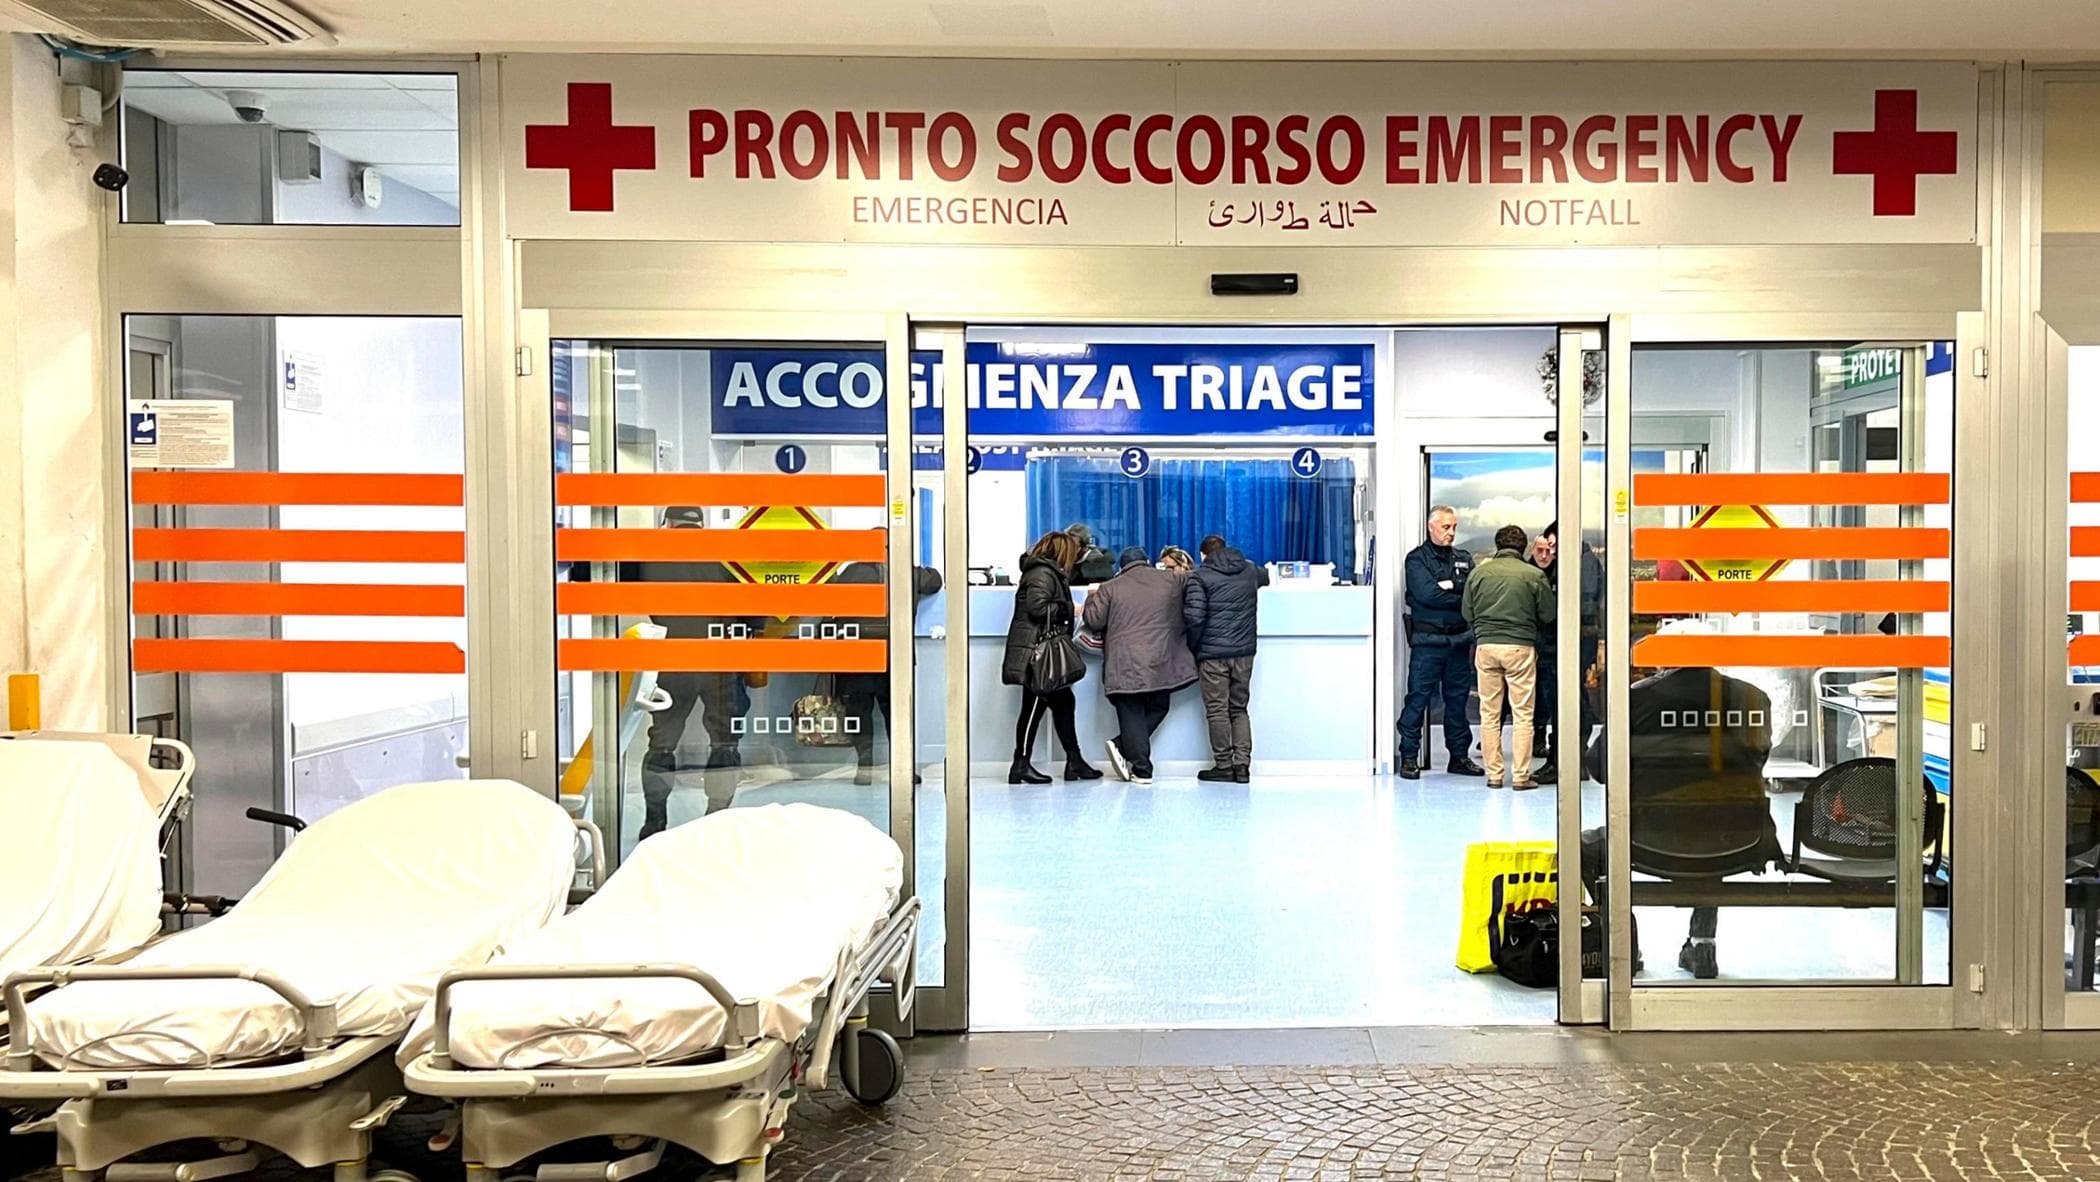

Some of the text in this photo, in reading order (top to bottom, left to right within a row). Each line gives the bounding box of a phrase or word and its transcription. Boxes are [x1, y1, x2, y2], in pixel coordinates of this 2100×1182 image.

[689, 108, 1803, 186] PRONTO SOCCORSO EMERGENCY
[853, 195, 1069, 225] EMERGENCIA
[1208, 200, 1377, 230] حالة طوارئ
[1500, 199, 1641, 226] NOTFALL
[1152, 364, 1362, 411] TRIAGE
[784, 447, 795, 470] 1
[1127, 449, 1143, 473] 3
[1298, 450, 1315, 473] 4
[764, 574, 800, 584] PORTE
[1717, 569, 1752, 580] PORTE
